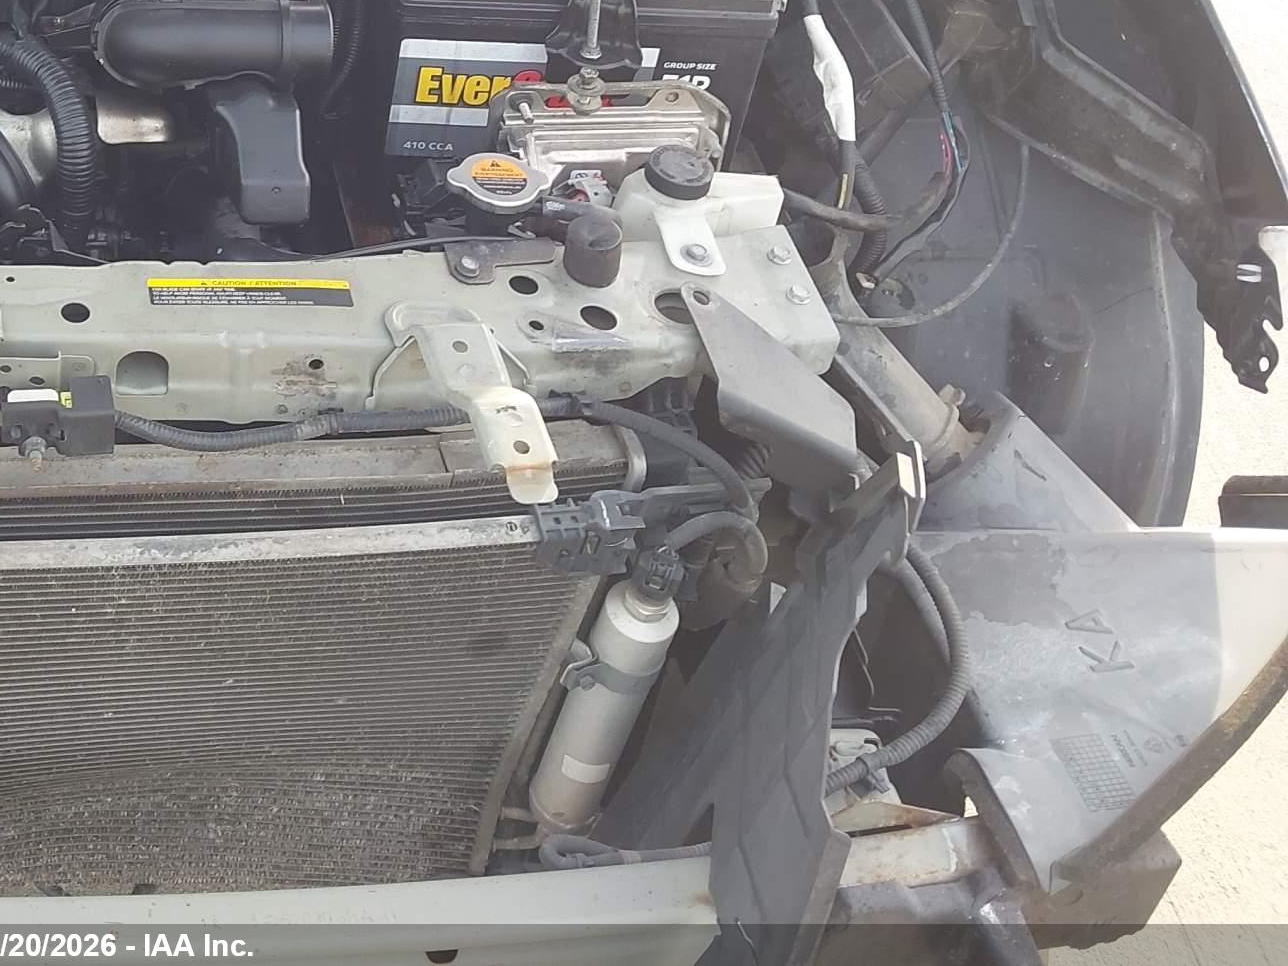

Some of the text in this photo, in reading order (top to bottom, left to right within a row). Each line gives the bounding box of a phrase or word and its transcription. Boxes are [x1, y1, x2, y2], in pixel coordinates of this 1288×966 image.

[663, 61, 718, 71] GROUP SIZE
[403, 141, 454, 151] 410 CCA
